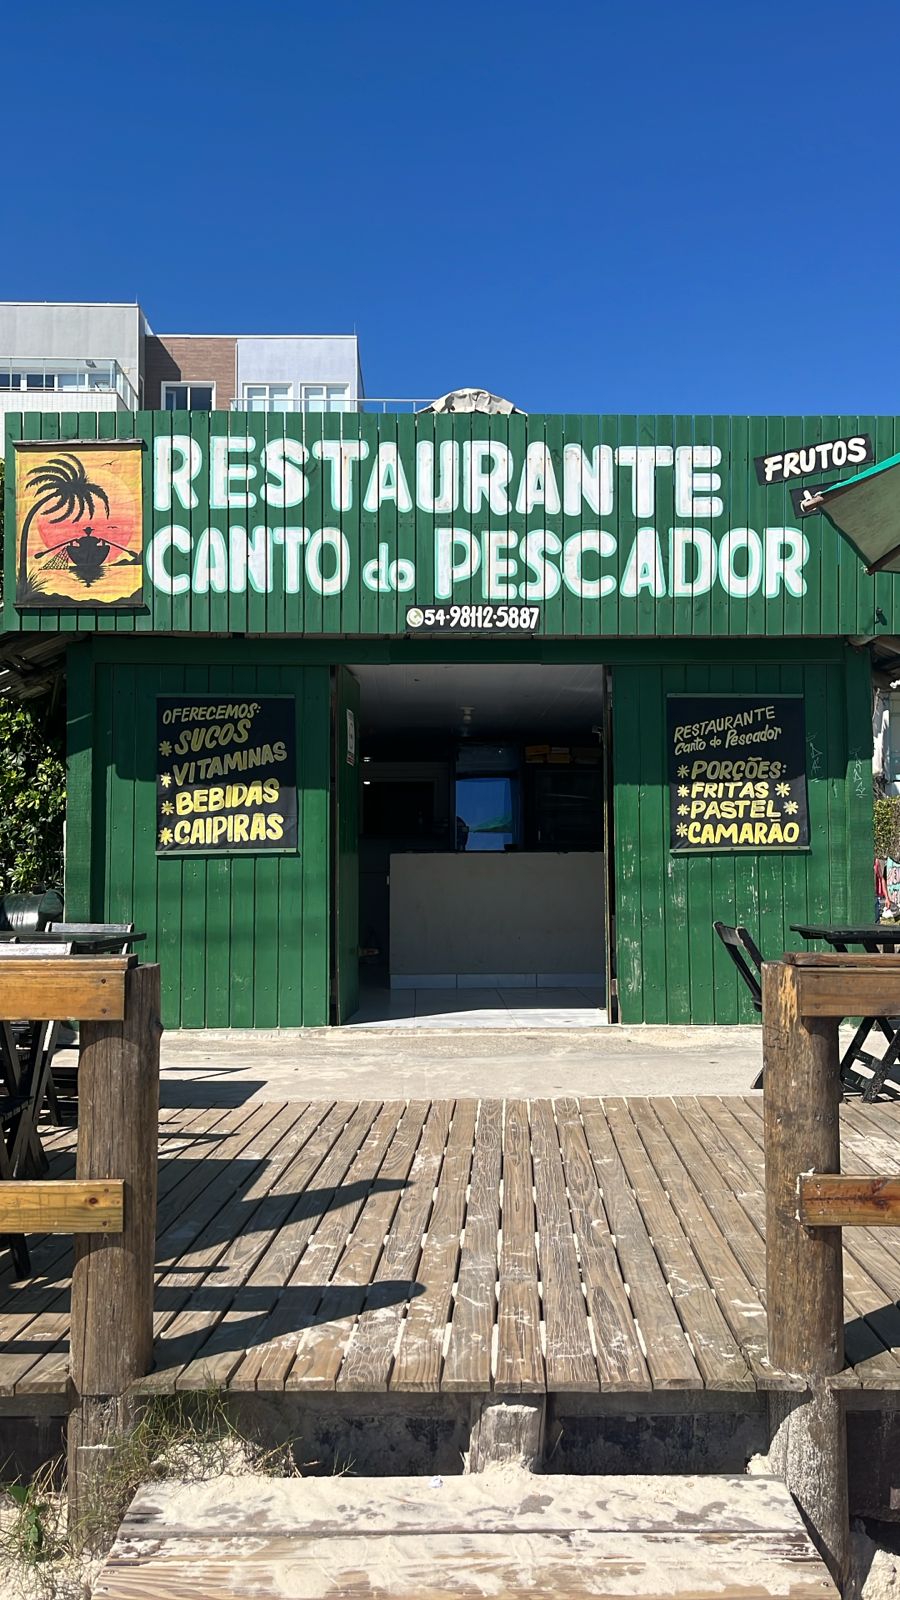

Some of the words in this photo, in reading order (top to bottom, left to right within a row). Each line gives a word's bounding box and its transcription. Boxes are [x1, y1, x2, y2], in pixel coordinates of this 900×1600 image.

[764, 437, 867, 481] FRUTOS
[153, 435, 724, 518] RESTAURANTE
[146, 525, 350, 596] CANTO
[362, 542, 416, 593] do
[434, 527, 810, 600] PESCADOR
[162, 703, 262, 725] OFERECEMOS:
[674, 705, 776, 743] RESTAURANTE
[174, 719, 251, 755] SUCOS
[674, 738, 707, 756] Canto
[709, 736, 722, 749] do
[725, 724, 782, 749] Pescador
[172, 741, 288, 786] VITAMINAS
[691, 757, 787, 781] PORÇÕES:
[175, 778, 280, 816] BEBIDAS
[691, 782, 770, 799] FRITAS
[690, 800, 782, 820] PASTEL
[174, 813, 284, 845] CAIPIRAS
[687, 818, 800, 845] CAMARÃO
